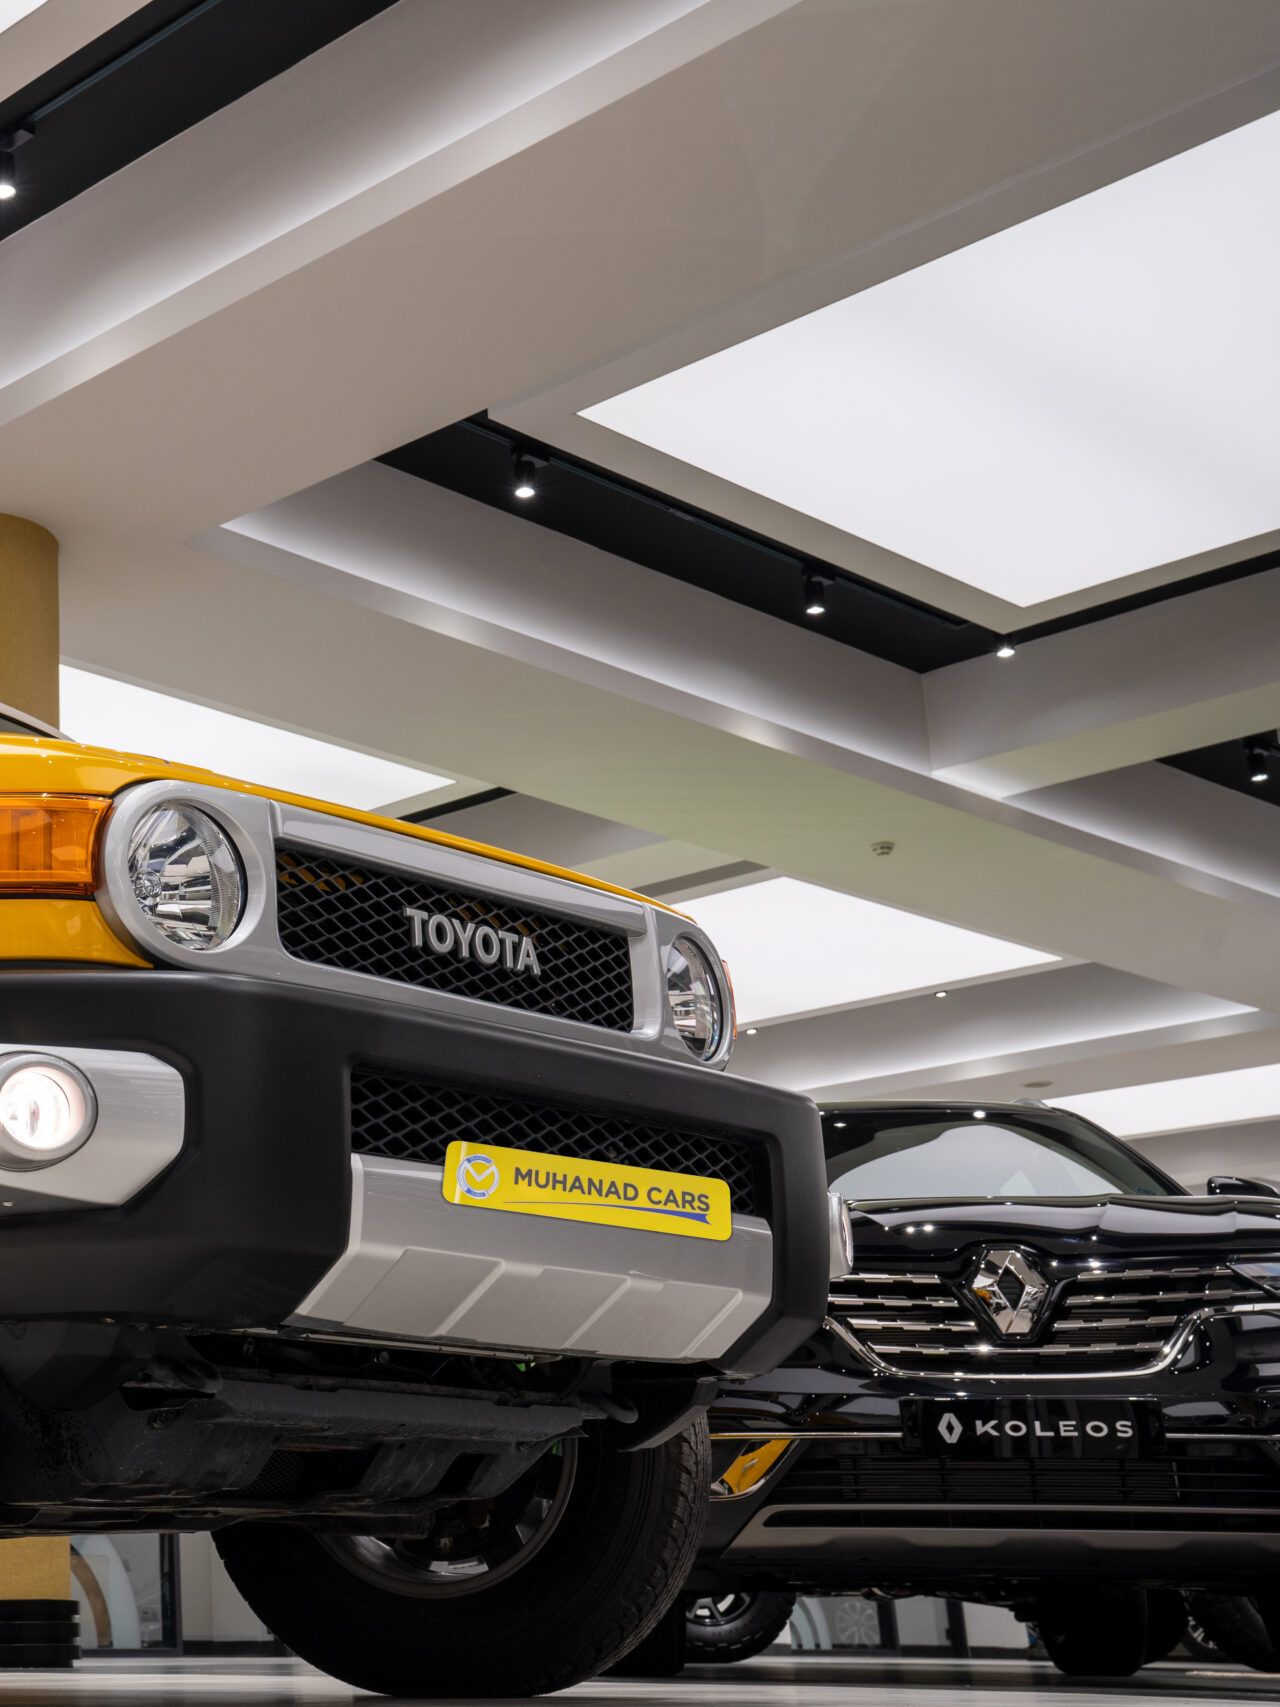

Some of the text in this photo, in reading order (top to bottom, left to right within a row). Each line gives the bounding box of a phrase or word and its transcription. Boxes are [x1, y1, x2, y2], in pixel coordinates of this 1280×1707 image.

[403, 907, 541, 977] TOYOTA
[514, 1167, 710, 1212] MUHANAD CARS
[975, 1420, 1133, 1438] KOLEOS
